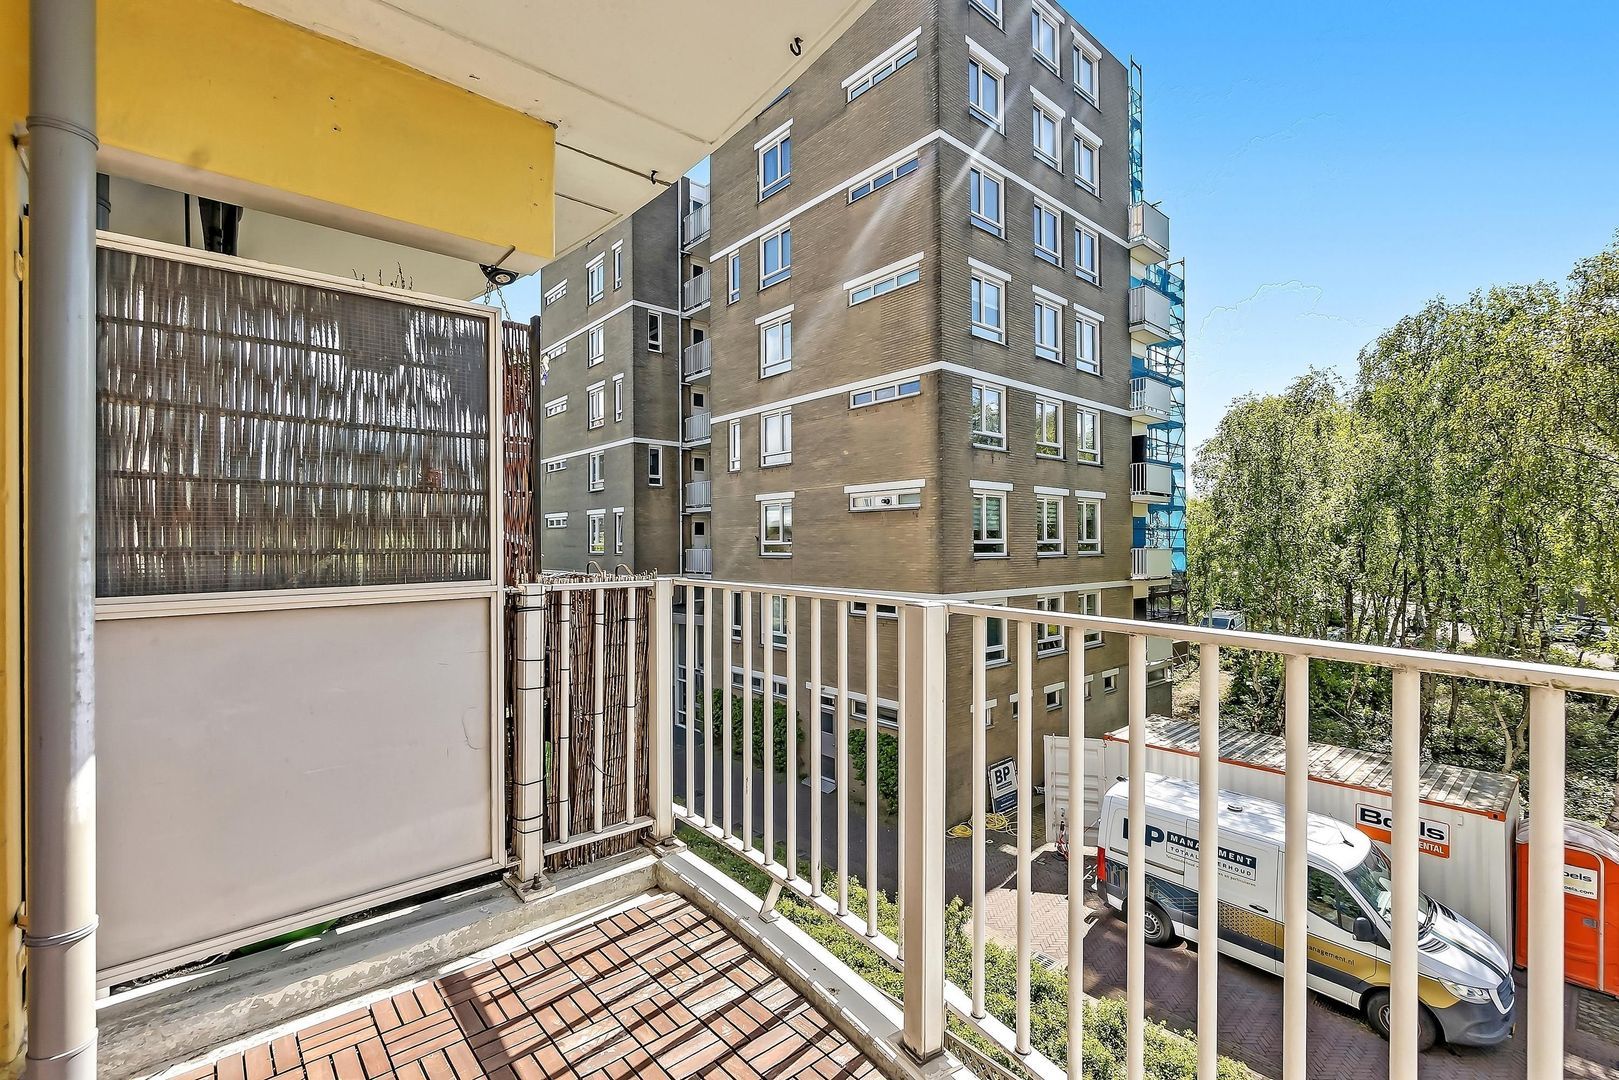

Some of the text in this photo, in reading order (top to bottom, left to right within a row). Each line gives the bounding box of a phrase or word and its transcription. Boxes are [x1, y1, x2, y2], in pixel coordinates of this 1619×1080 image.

[995, 766, 1010, 785] BP
[1123, 817, 1165, 848] P
[1360, 808, 1445, 841] Bols
[1170, 834, 1253, 865] MANAMENT
[1419, 842, 1444, 854] ENTAL
[1564, 871, 1592, 882] oels
[1564, 886, 1595, 895] oels.com
[1307, 945, 1355, 966] anagement.nl
